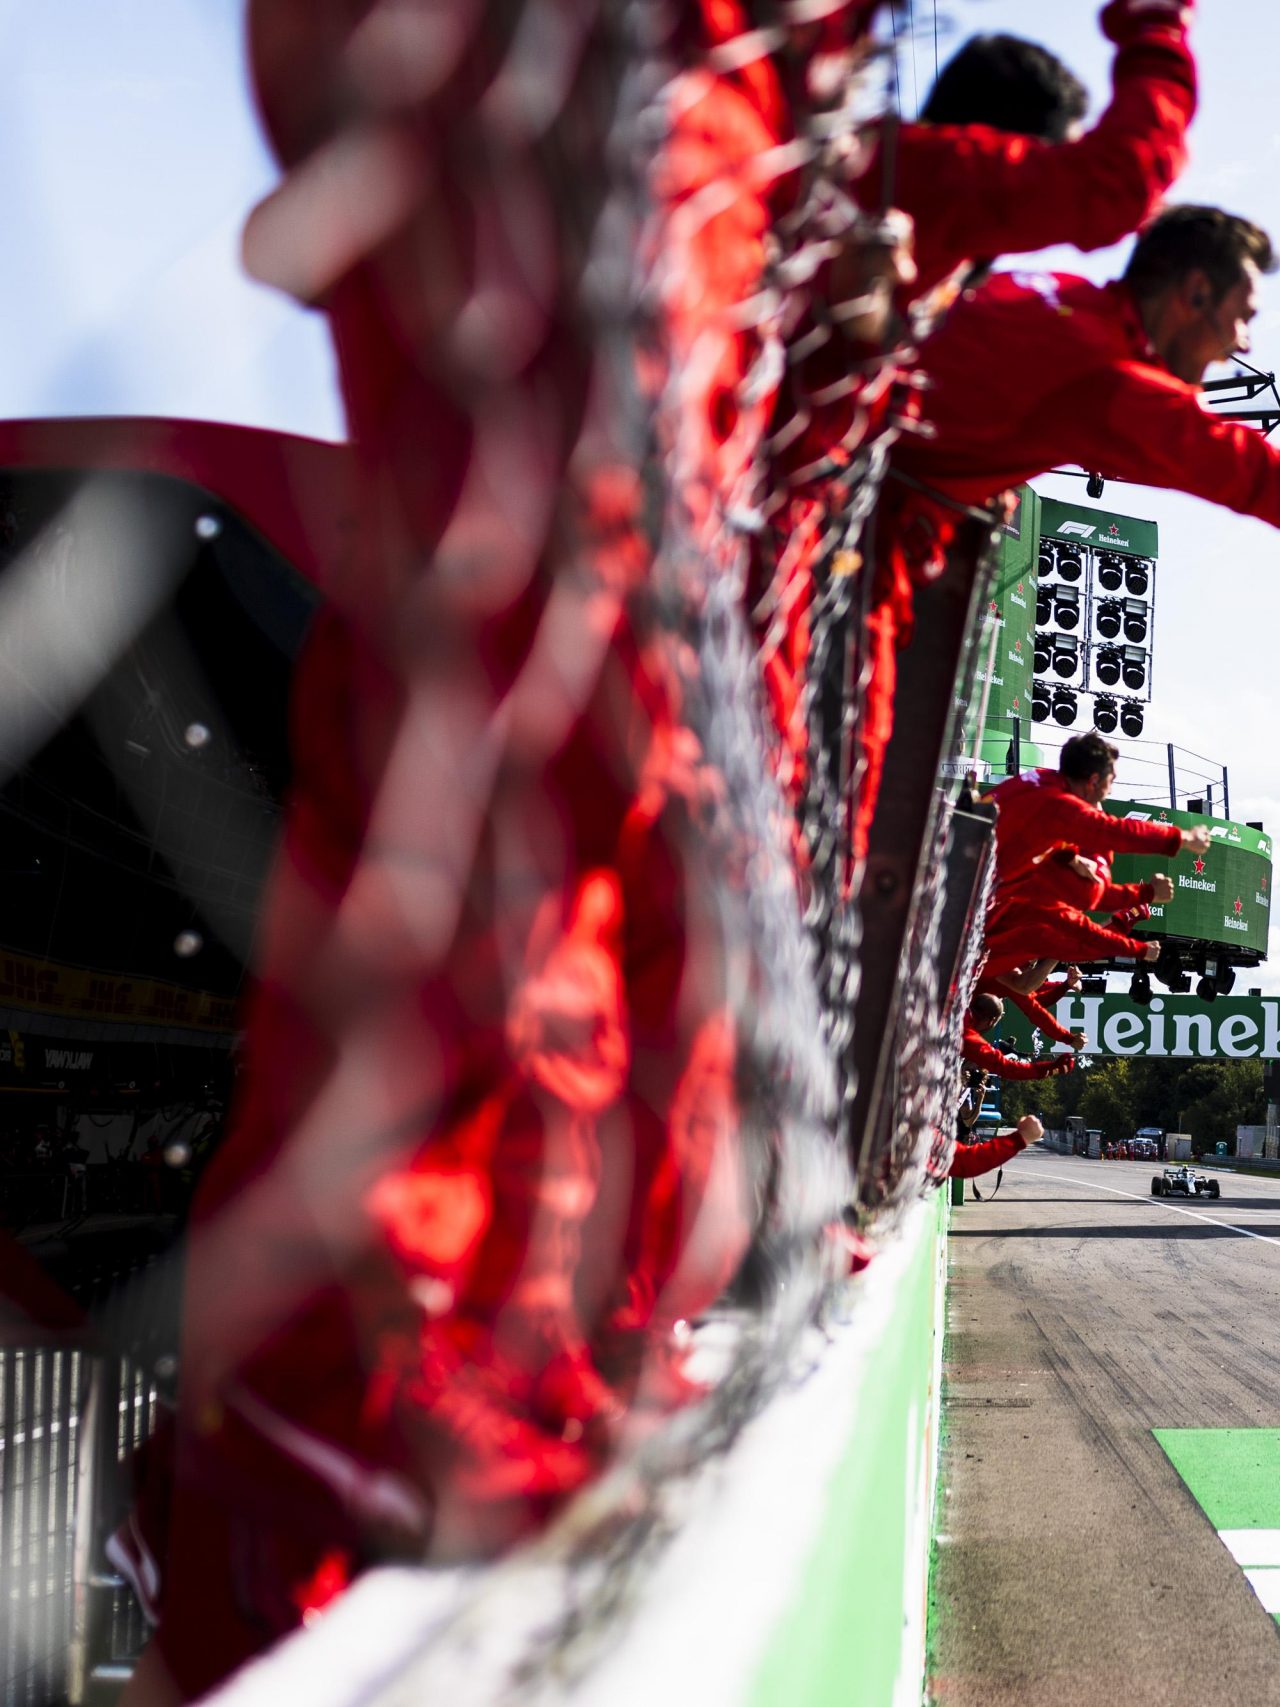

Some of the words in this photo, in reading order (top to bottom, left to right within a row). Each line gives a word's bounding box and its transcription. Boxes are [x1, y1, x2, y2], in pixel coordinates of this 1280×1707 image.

[1057, 521, 1097, 538] F1
[1099, 534, 1129, 547] Heineken
[1179, 875, 1216, 892] Heineken
[1224, 915, 1248, 931] Heineken
